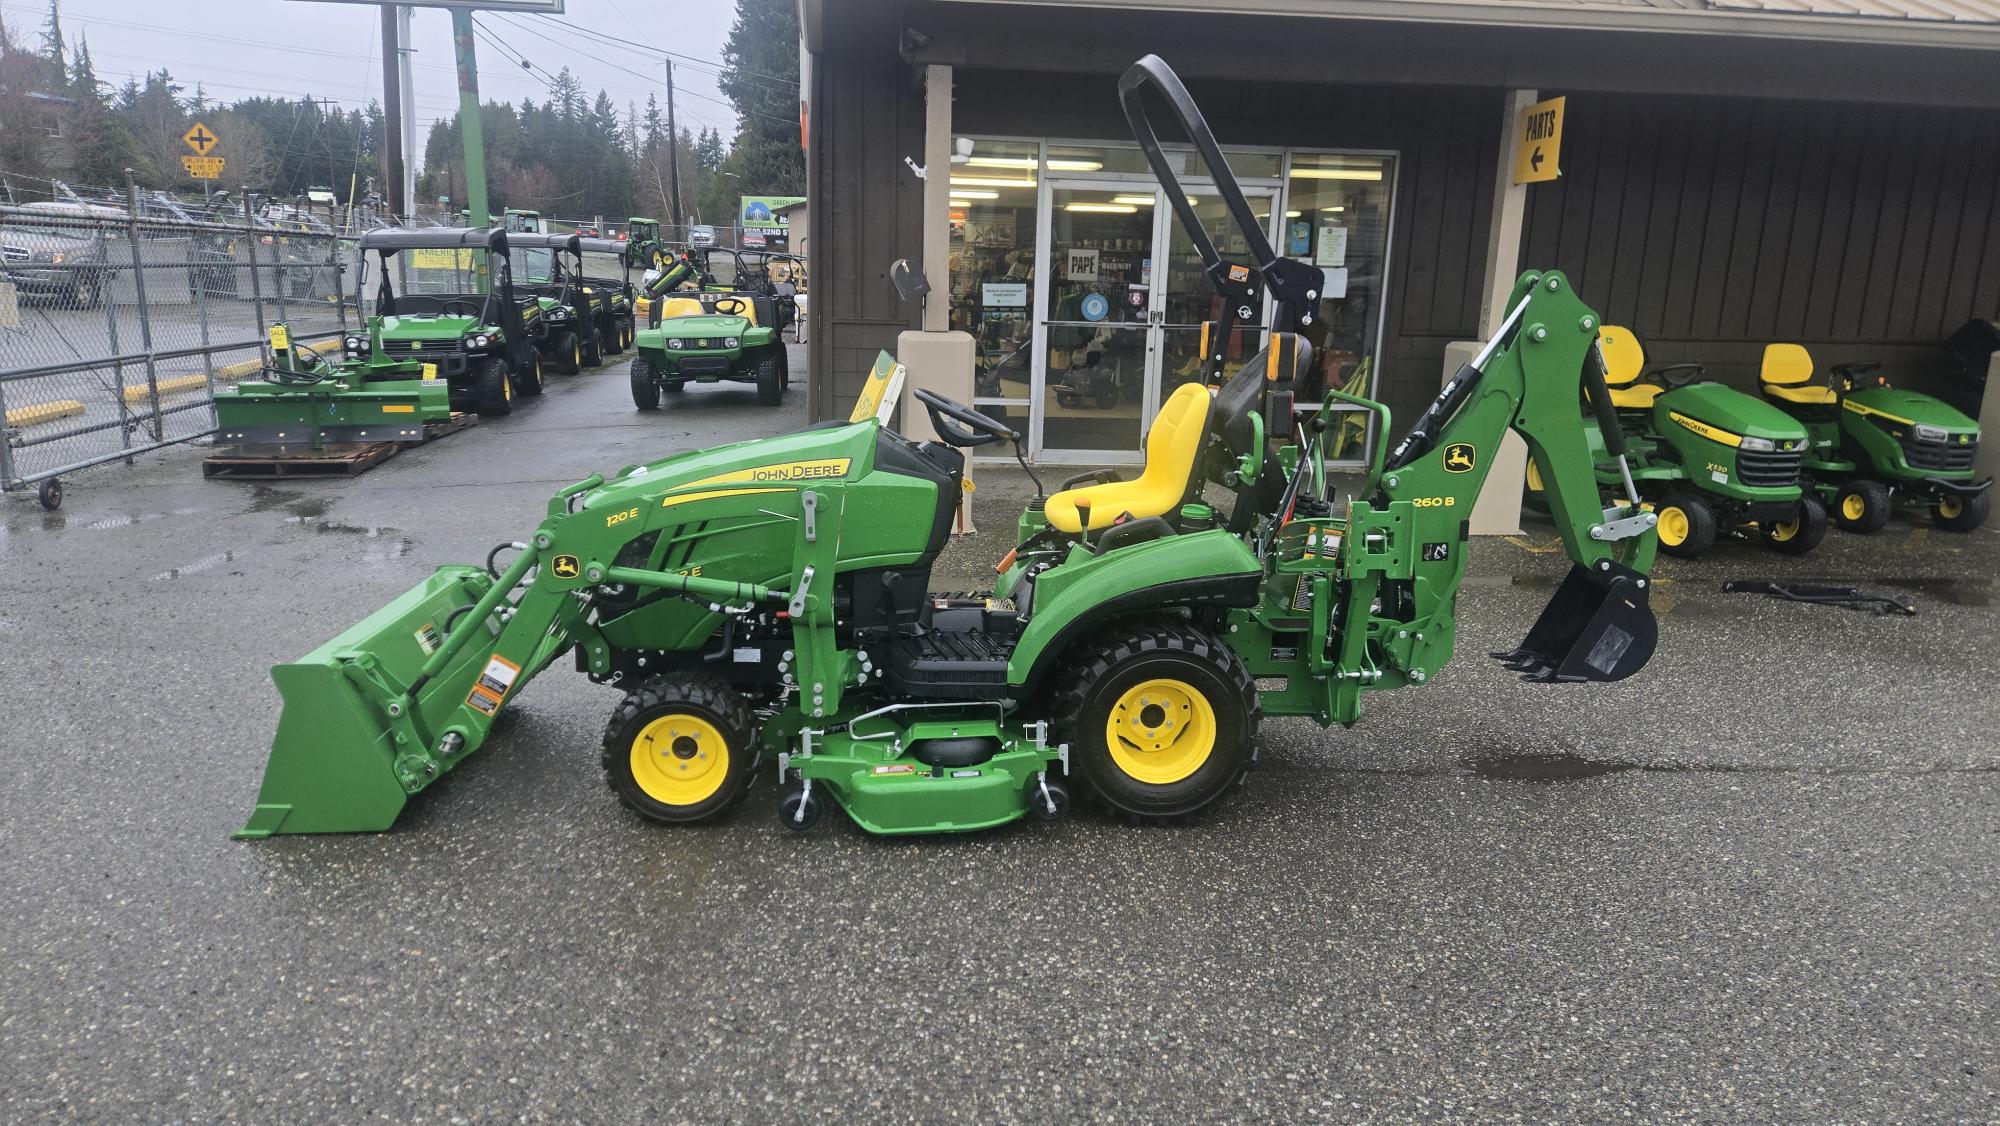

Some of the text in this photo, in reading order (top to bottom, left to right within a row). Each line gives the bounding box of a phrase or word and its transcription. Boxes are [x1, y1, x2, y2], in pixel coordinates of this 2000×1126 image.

[1525, 109, 1556, 142] PARTS
[763, 228, 781, 236] 52ND
[1101, 262, 1132, 271] MACHINERY
[752, 465, 841, 481] JOHN DEERE
